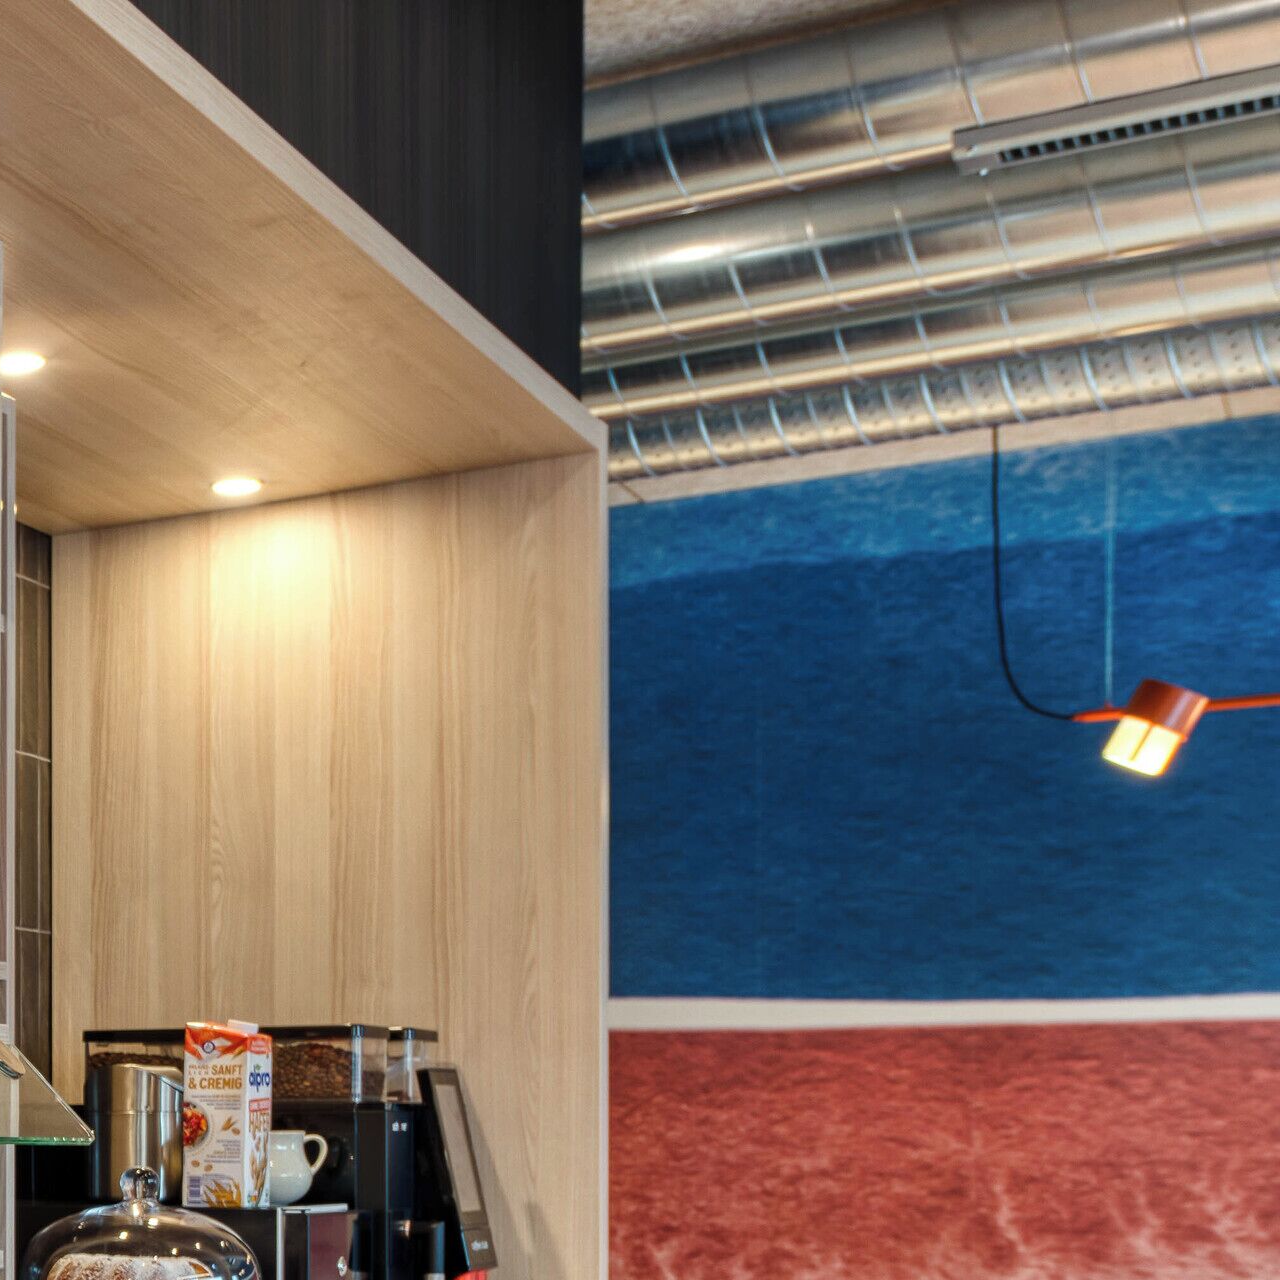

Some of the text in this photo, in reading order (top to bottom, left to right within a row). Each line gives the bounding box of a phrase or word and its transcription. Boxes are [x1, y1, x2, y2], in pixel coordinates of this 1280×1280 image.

[211, 1064, 243, 1075] SANFT
[199, 1077, 243, 1090] CREMIG
[249, 1065, 271, 1093] alpro
